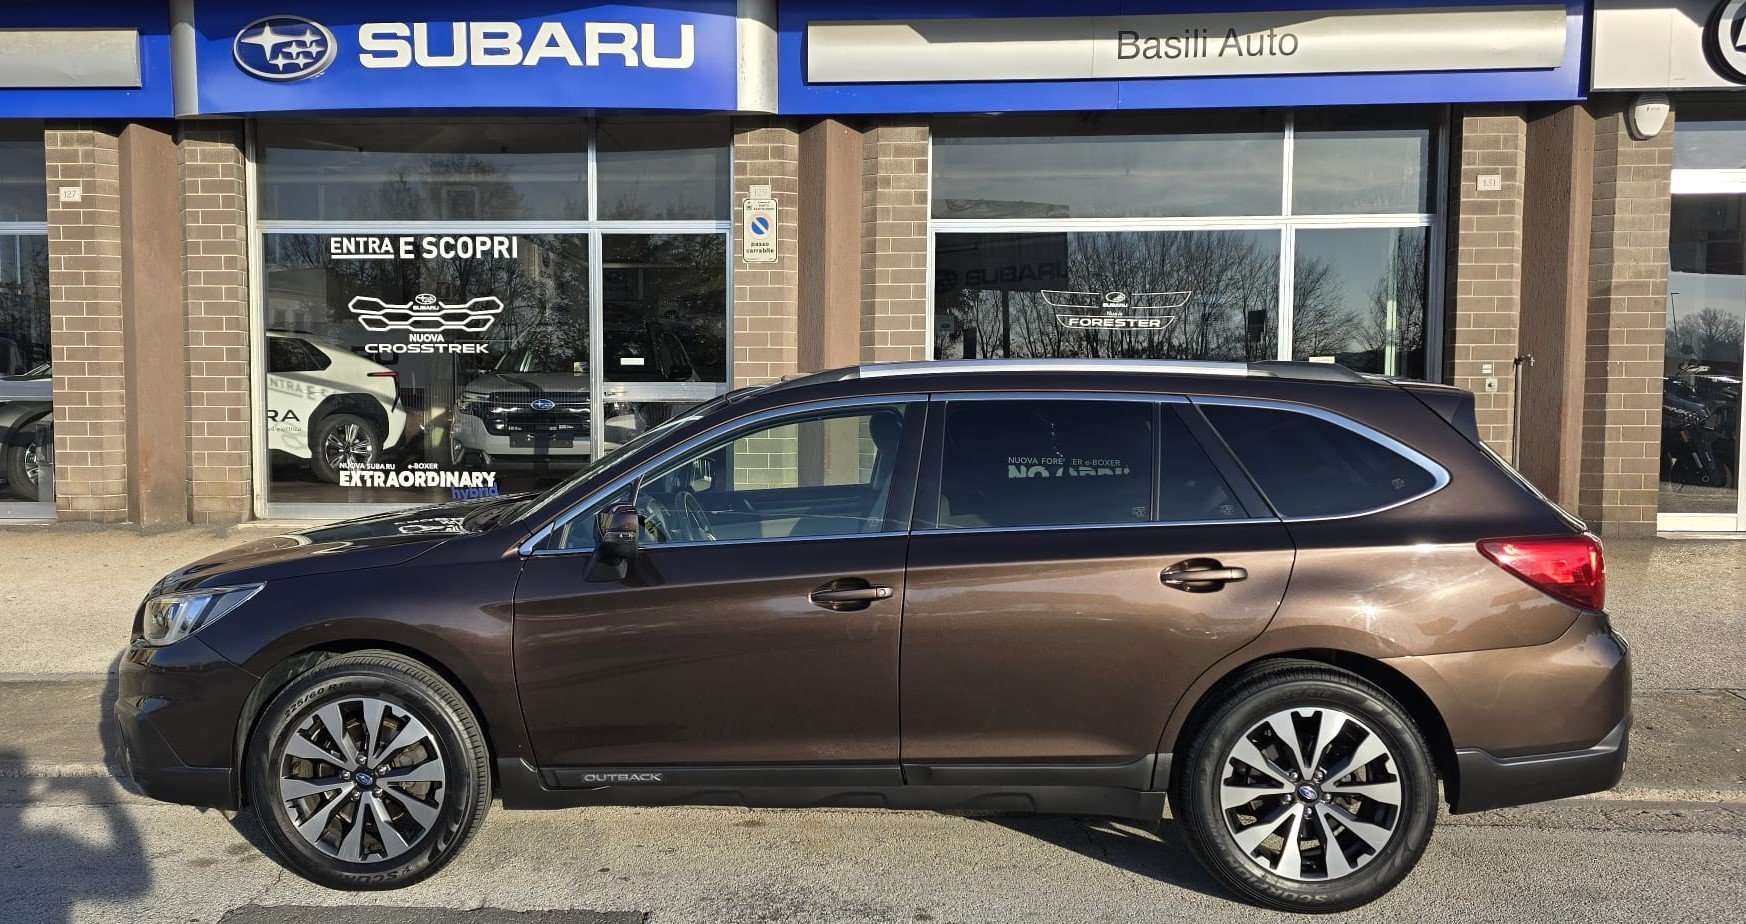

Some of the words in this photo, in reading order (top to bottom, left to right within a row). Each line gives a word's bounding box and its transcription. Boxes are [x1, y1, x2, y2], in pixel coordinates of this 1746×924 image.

[359, 21, 695, 69] SUBARU
[1117, 28, 1207, 60] Basili
[1218, 27, 1299, 57] Auto
[330, 237, 394, 254] ENTRA
[400, 237, 415, 258] E
[422, 236, 517, 259] SCOPRI
[1068, 318, 1161, 328] FORESTER
[409, 334, 444, 342] NUOVA
[364, 344, 489, 354] CROSSTREK
[339, 471, 496, 487] EXTRAORDINARY
[451, 484, 499, 499] hybrid
[584, 773, 662, 782] OUTBACK
